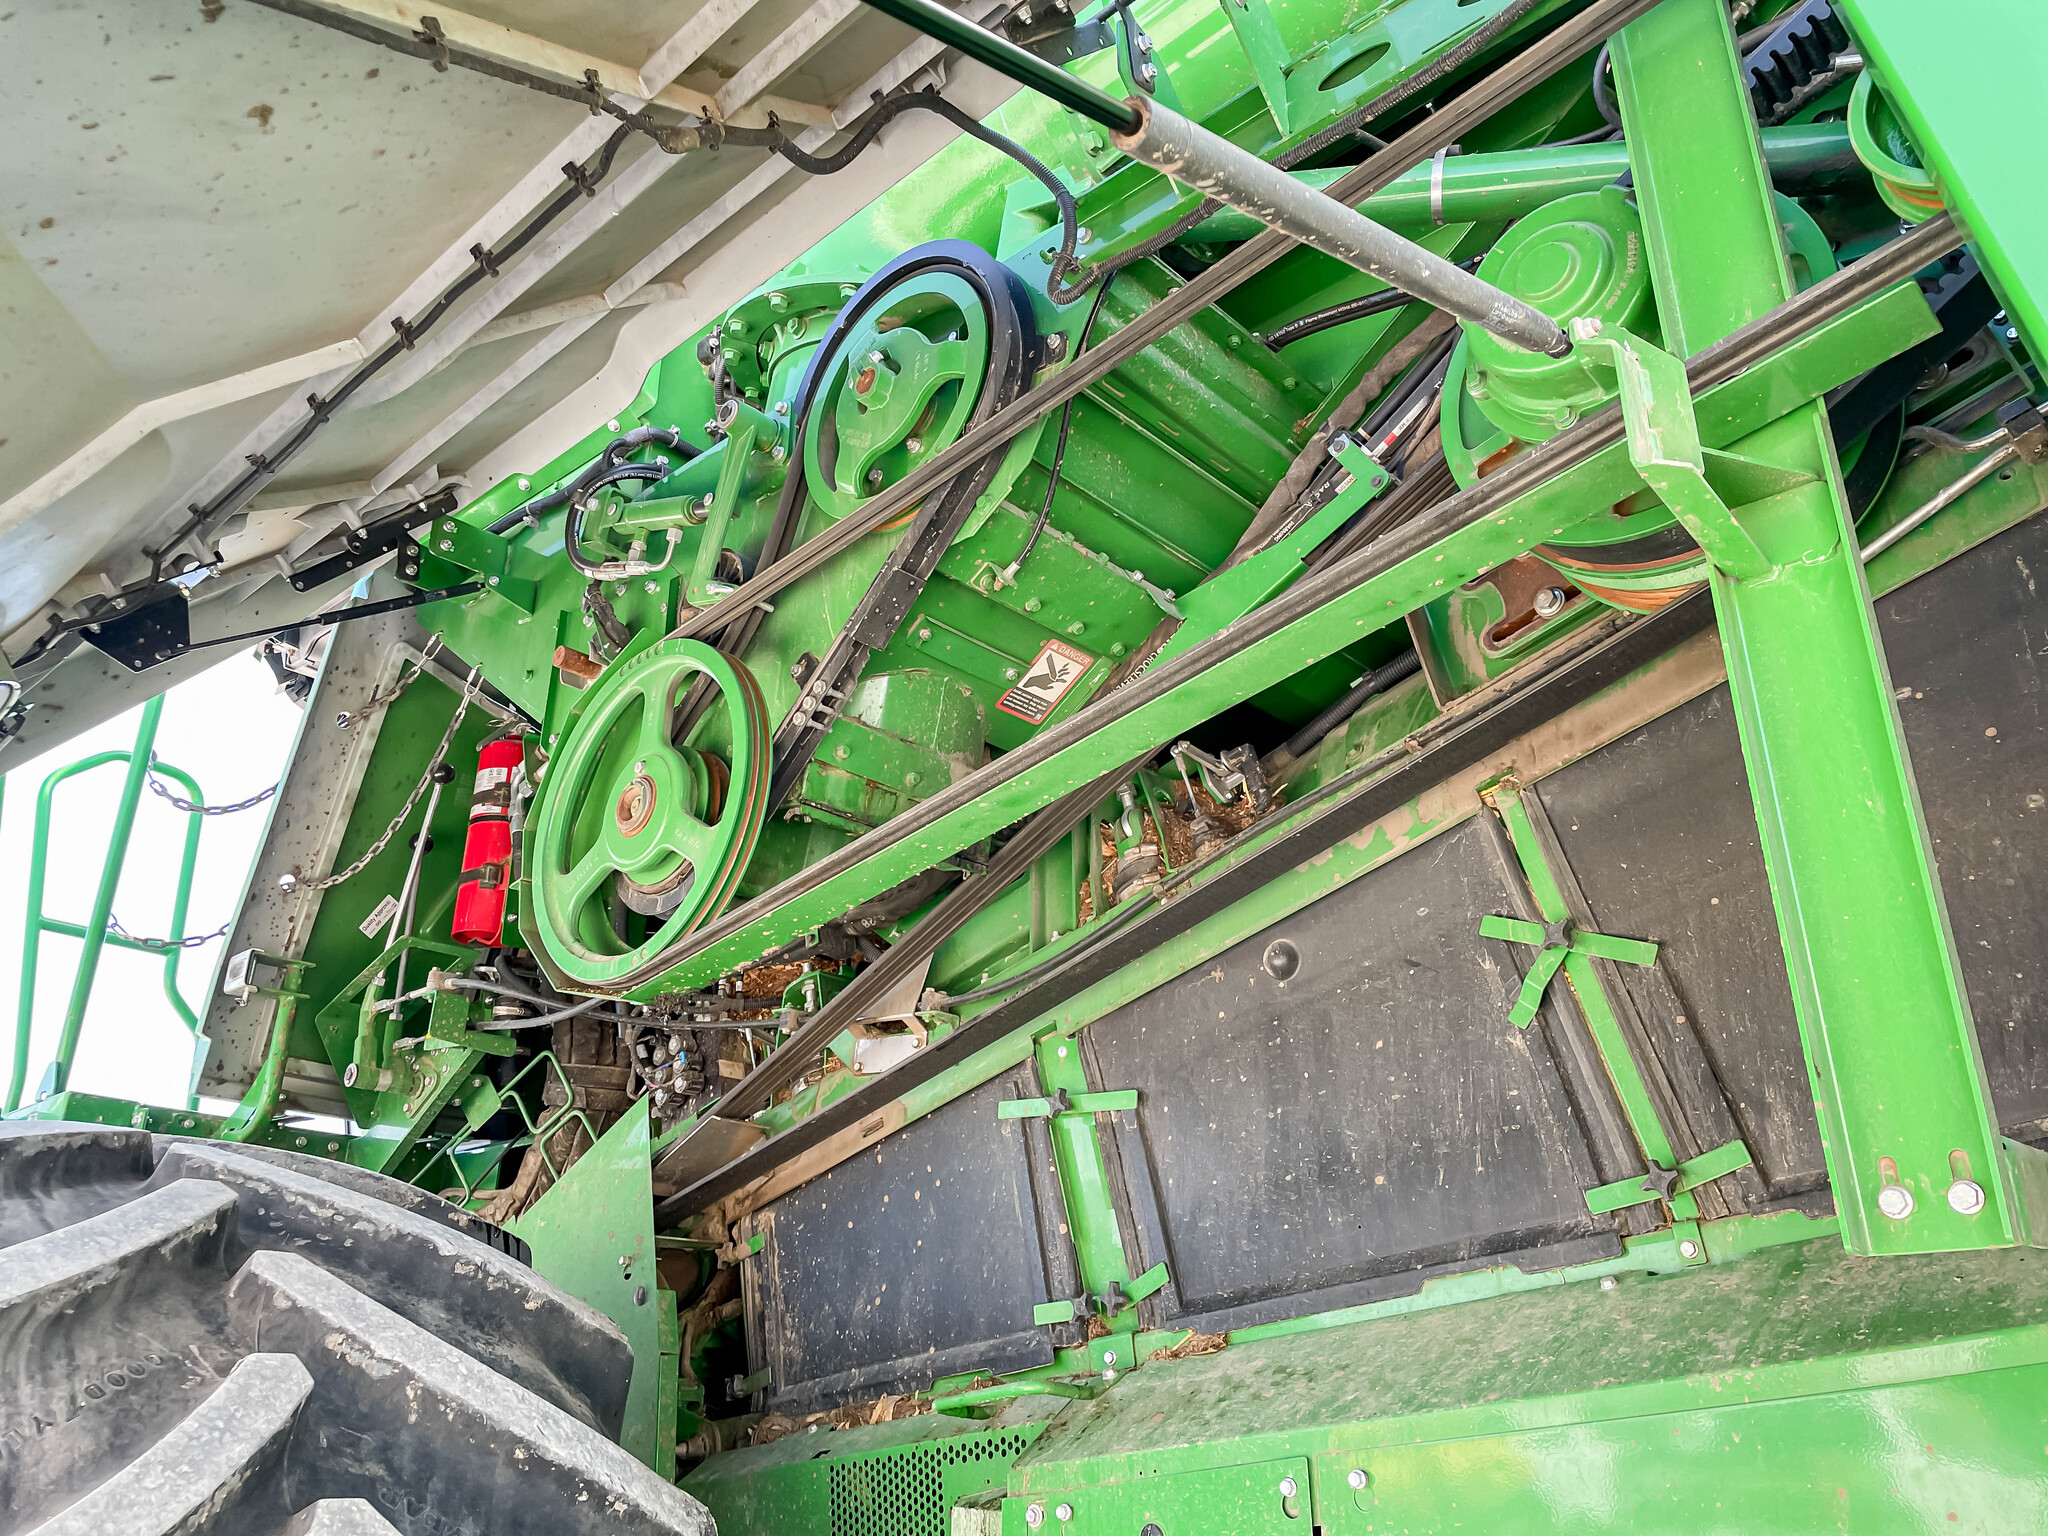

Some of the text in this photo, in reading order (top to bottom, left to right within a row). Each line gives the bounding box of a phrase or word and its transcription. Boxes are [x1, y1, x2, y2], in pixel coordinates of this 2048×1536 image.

[1273, 520, 1295, 542] WARNING
[1058, 645, 1091, 666] DANGER
[362, 917, 376, 932] Quality
[375, 900, 391, 918] Approval
